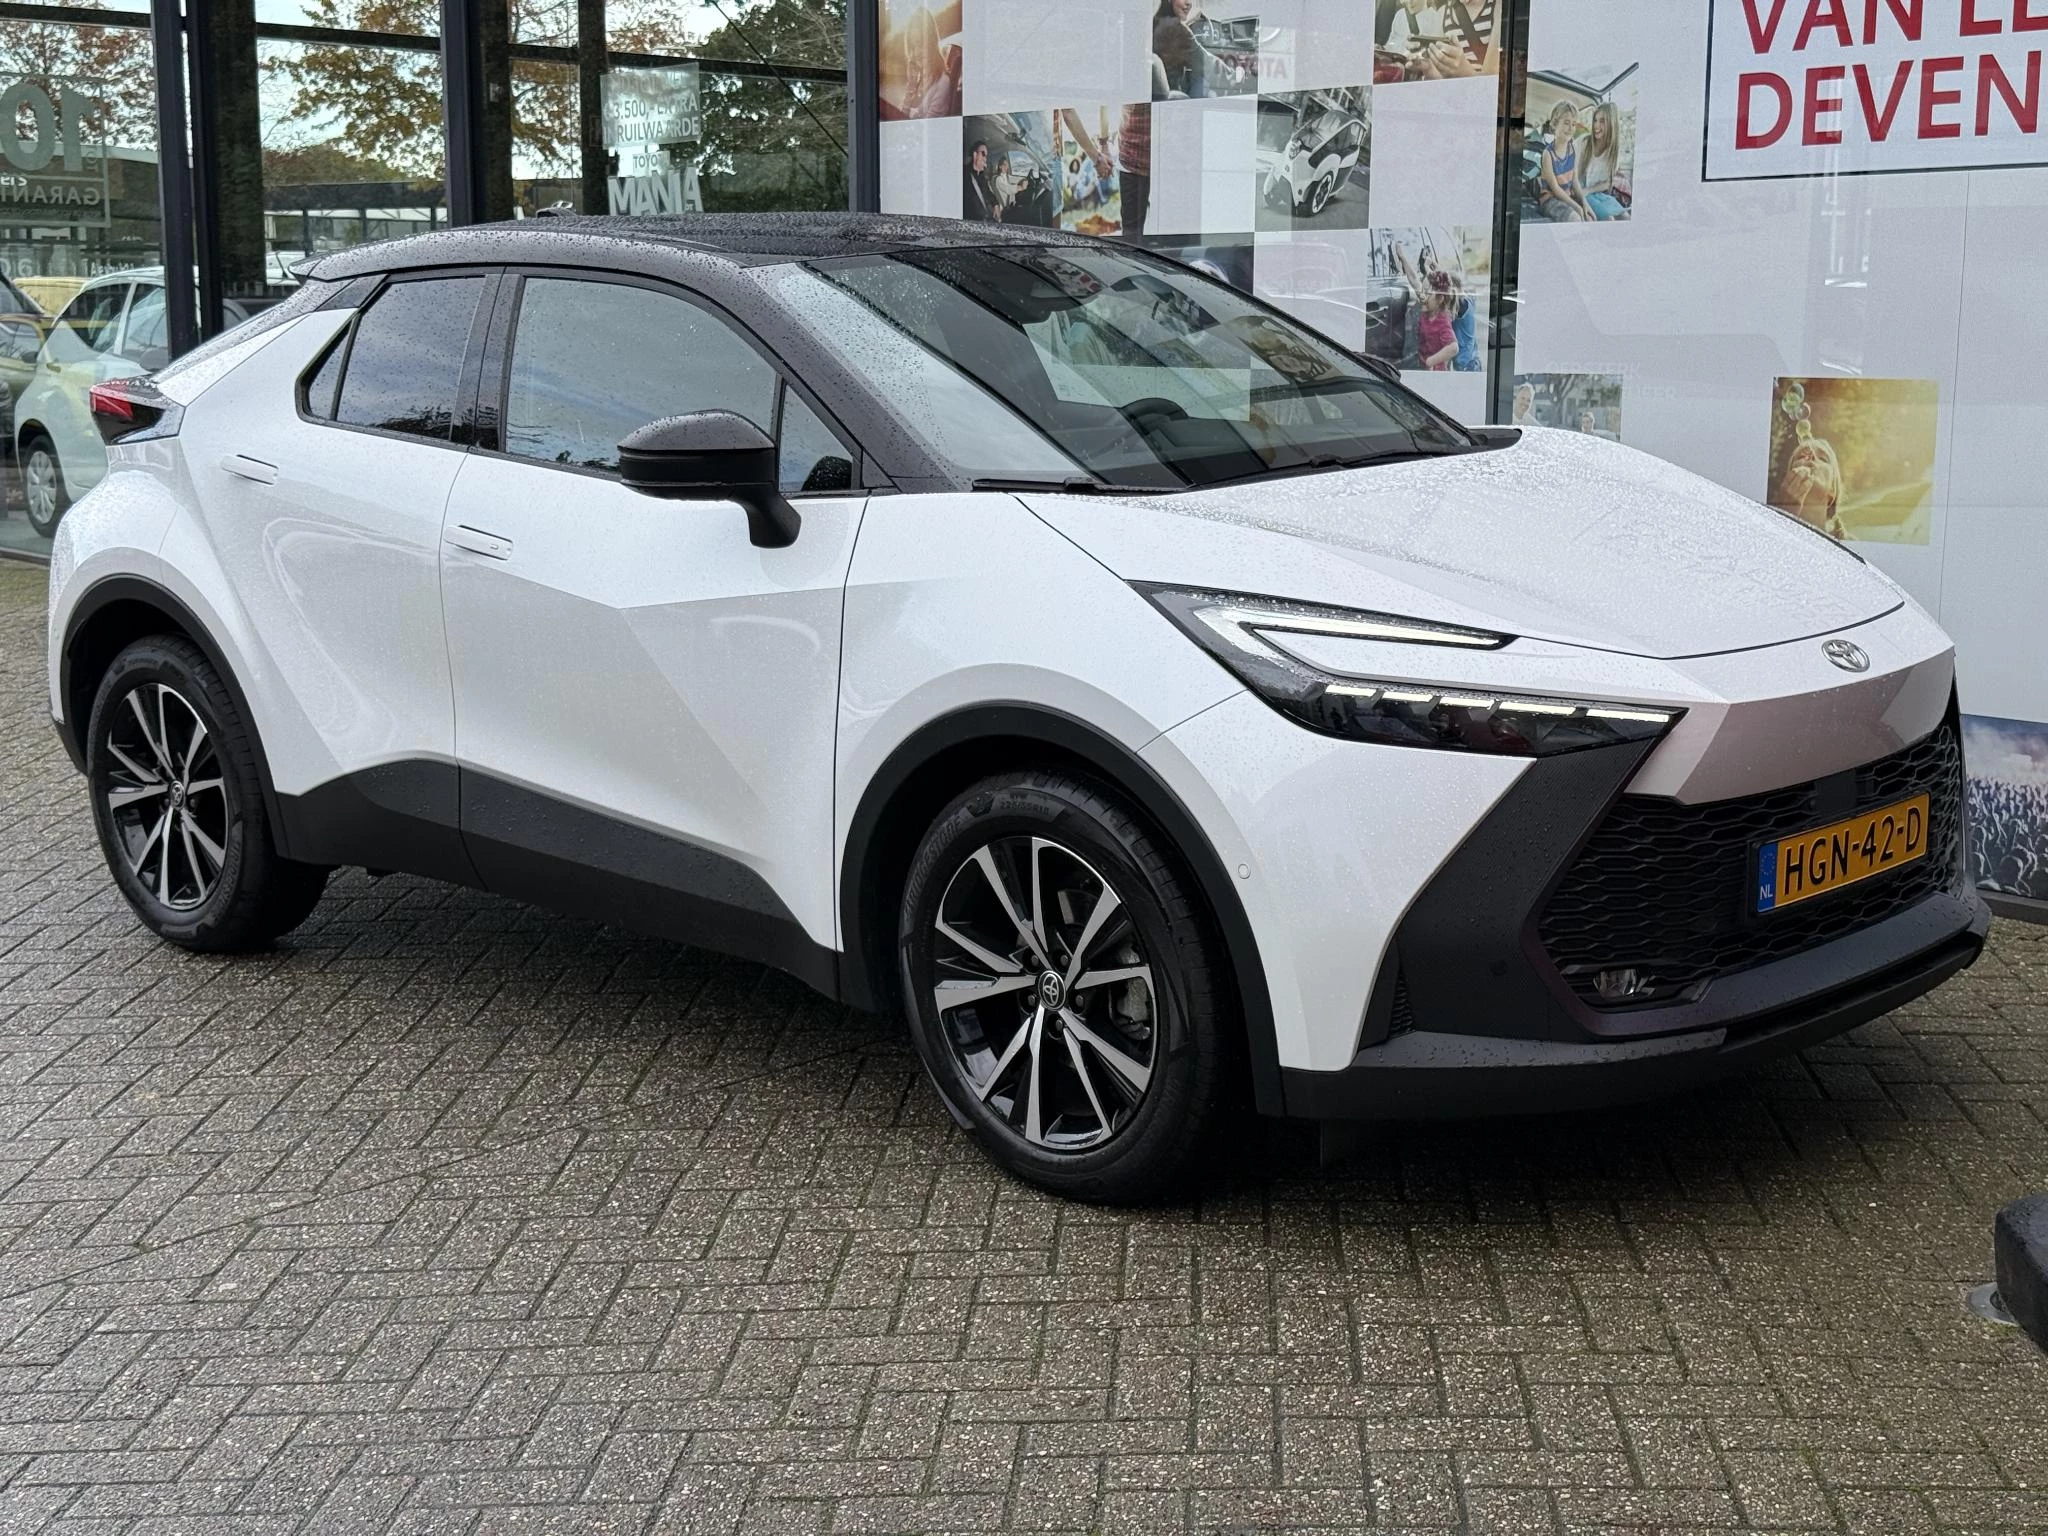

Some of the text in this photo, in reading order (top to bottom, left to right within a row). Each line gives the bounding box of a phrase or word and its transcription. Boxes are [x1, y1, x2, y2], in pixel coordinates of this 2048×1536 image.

[1742, 0, 1922, 54] VAN
[657, 92, 699, 115] EXTRA
[1735, 50, 2041, 151] DEVEN
[608, 167, 704, 216] MANIA
[1784, 806, 1922, 897] HGN-42-D
[1760, 884, 1773, 901] NL
